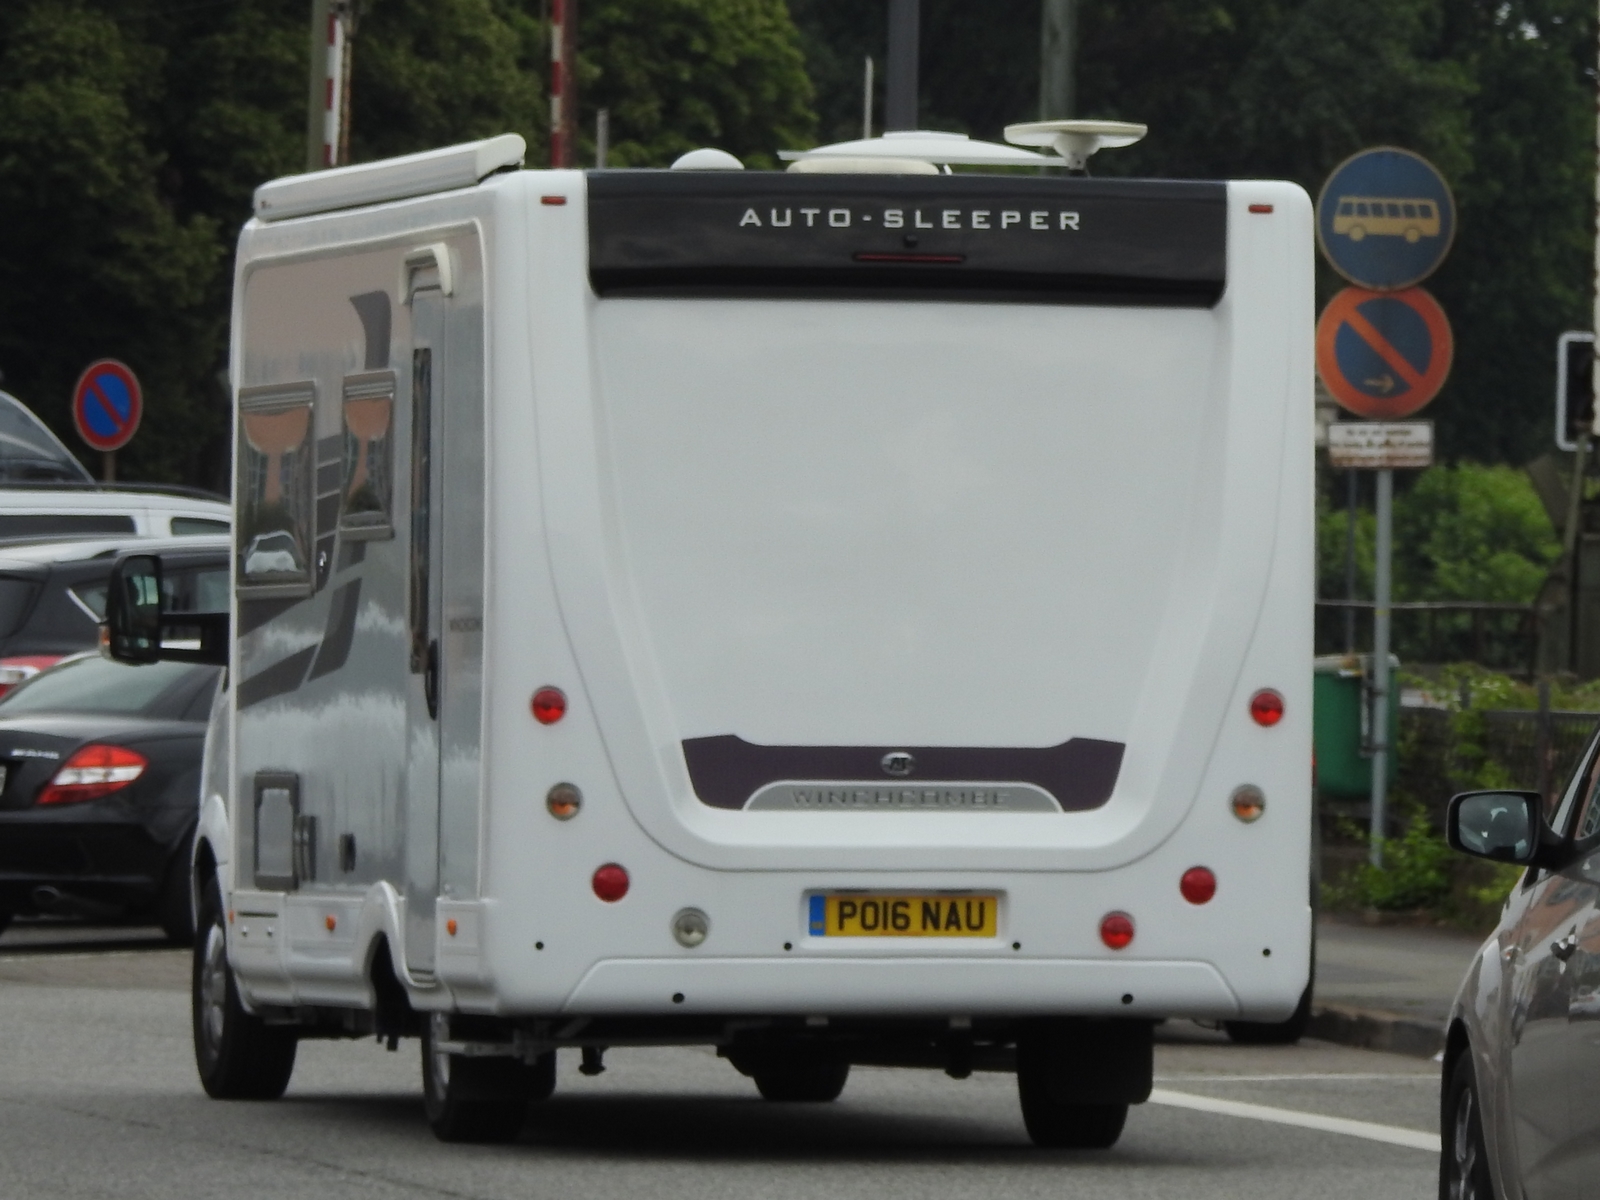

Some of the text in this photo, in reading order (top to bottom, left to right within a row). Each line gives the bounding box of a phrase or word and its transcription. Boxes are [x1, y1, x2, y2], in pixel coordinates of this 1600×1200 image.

[739, 208, 1081, 230] AUTO-SLEEPER
[792, 790, 1009, 808] WINCHCOMBE
[838, 900, 986, 931] PO16 NAU
